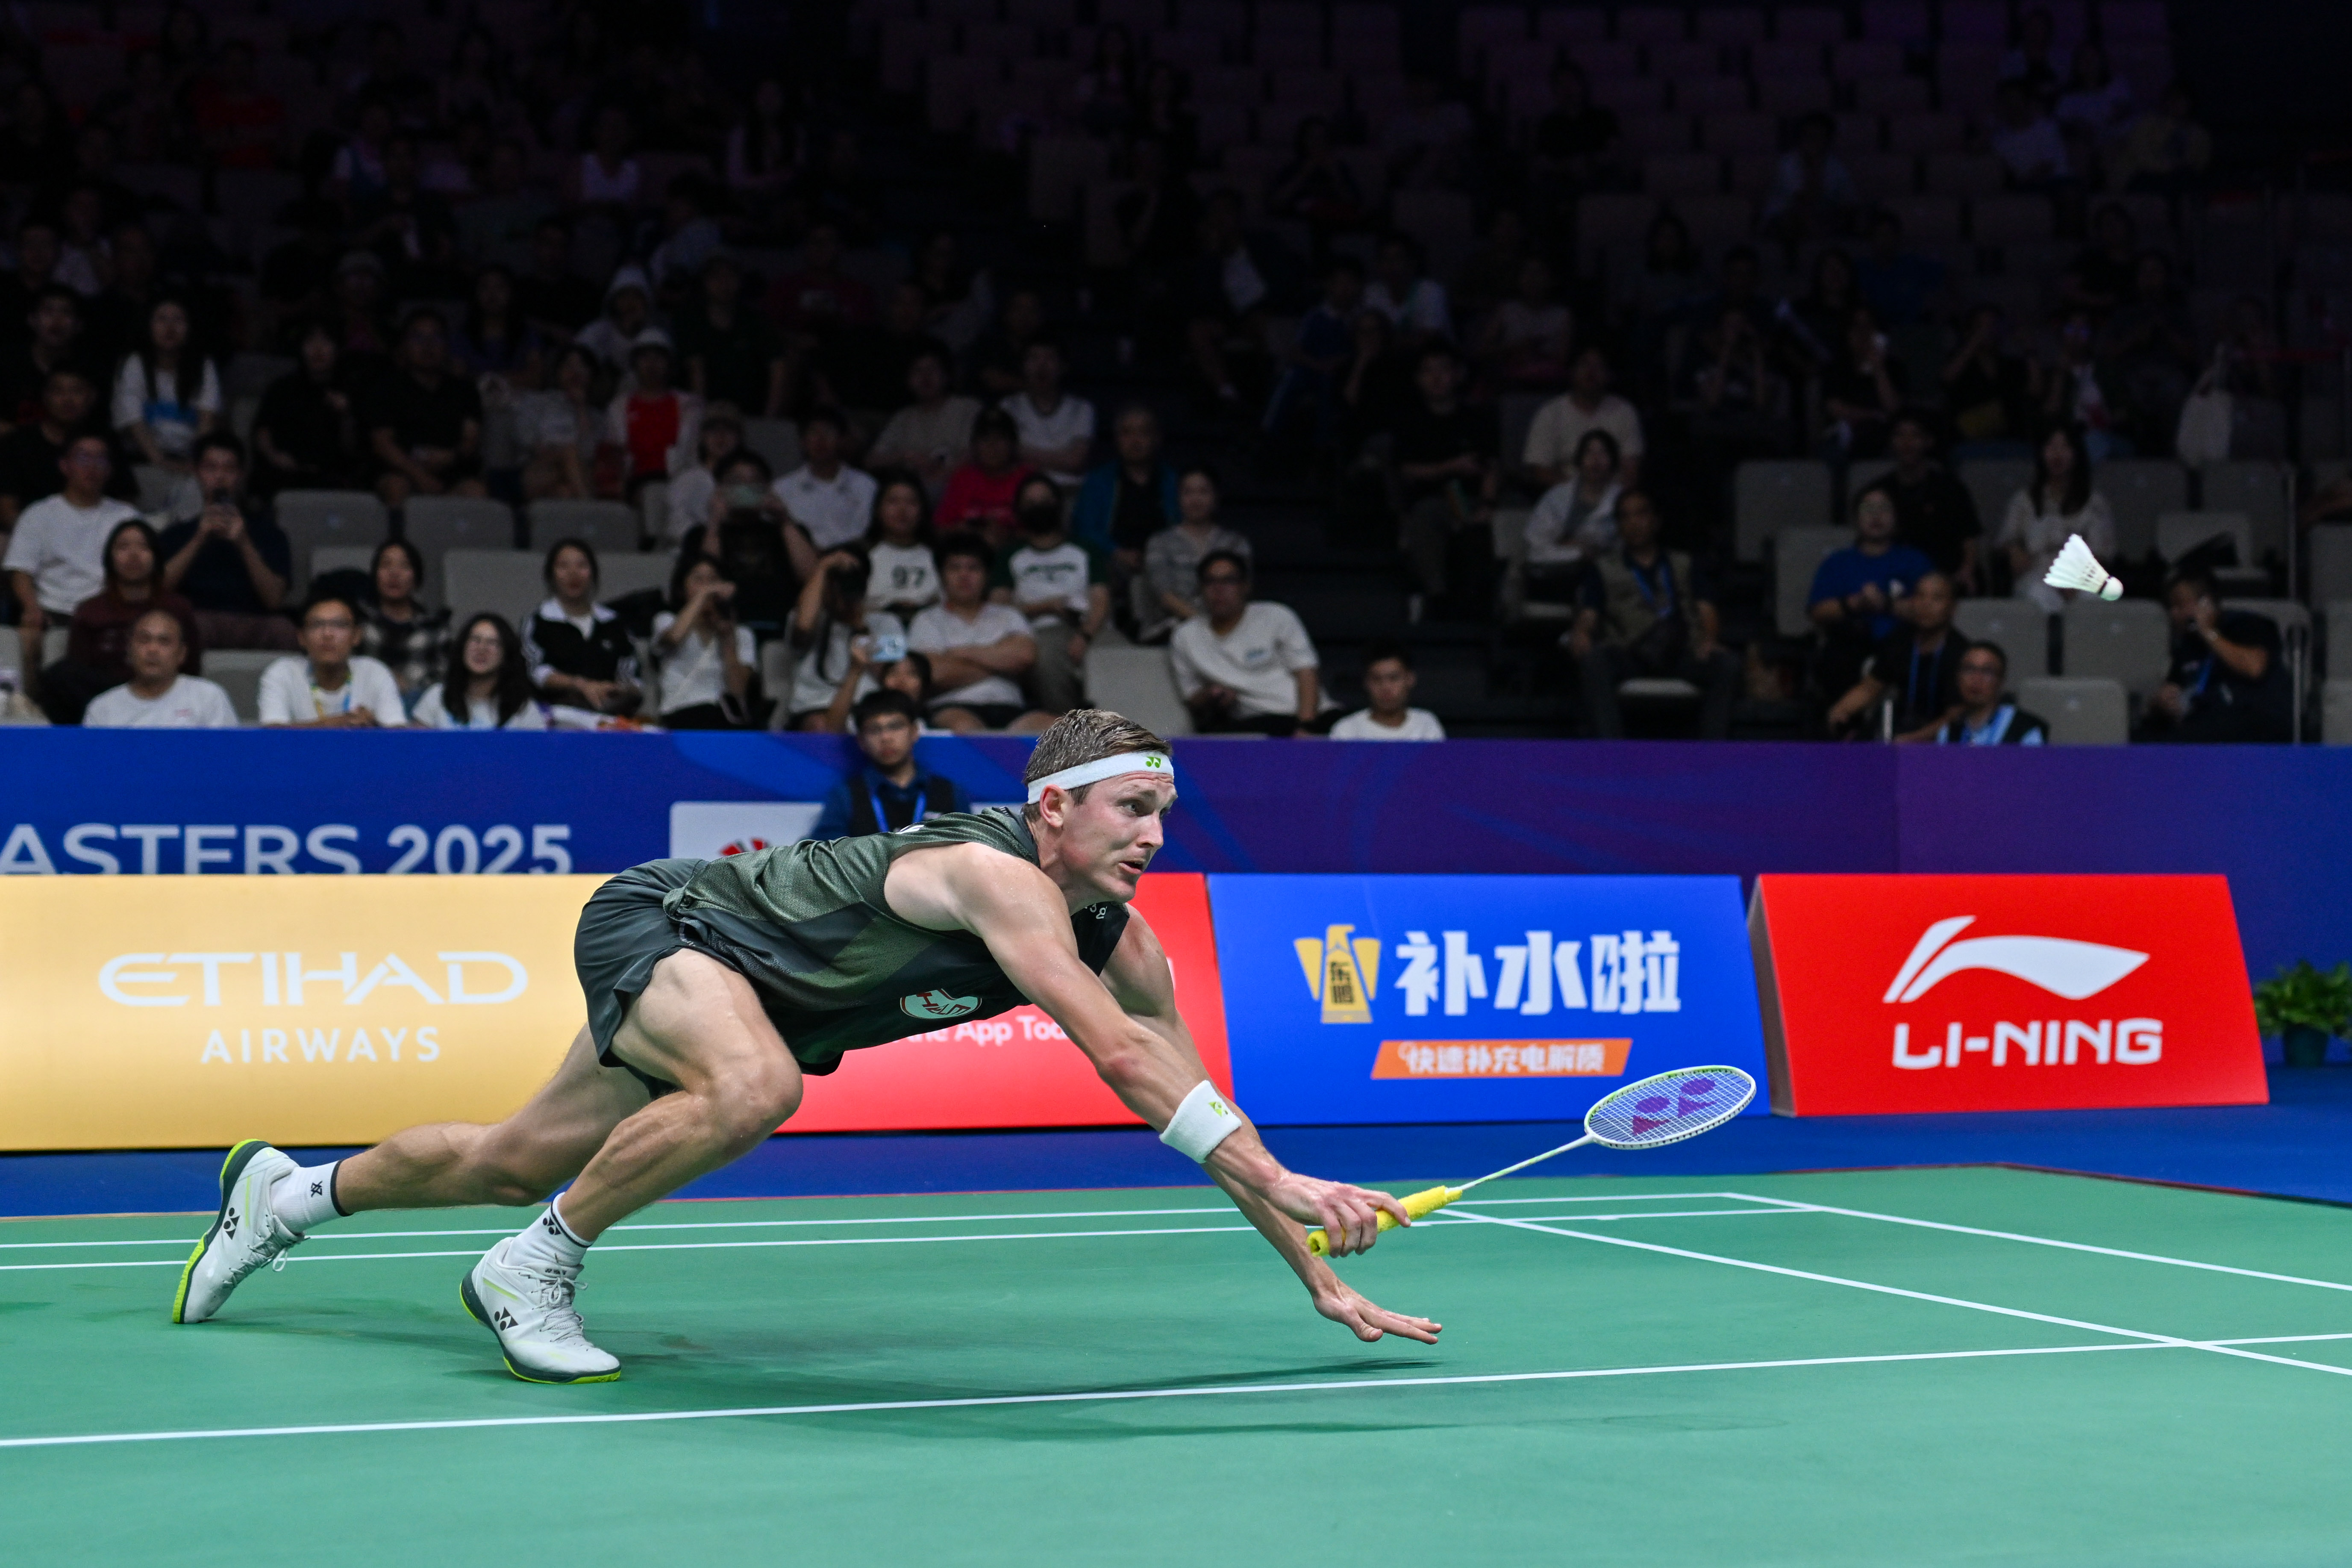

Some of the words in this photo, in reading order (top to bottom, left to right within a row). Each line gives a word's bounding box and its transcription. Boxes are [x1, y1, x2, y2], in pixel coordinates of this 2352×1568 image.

[385, 823, 573, 874] 2025
[98, 952, 529, 1006] ETIHAD
[1395, 930, 1682, 1016] 补水啦
[201, 1027, 441, 1064] AIRWAYS
[954, 1022, 1014, 1047] App
[1893, 1018, 2164, 1069] LI-NING
